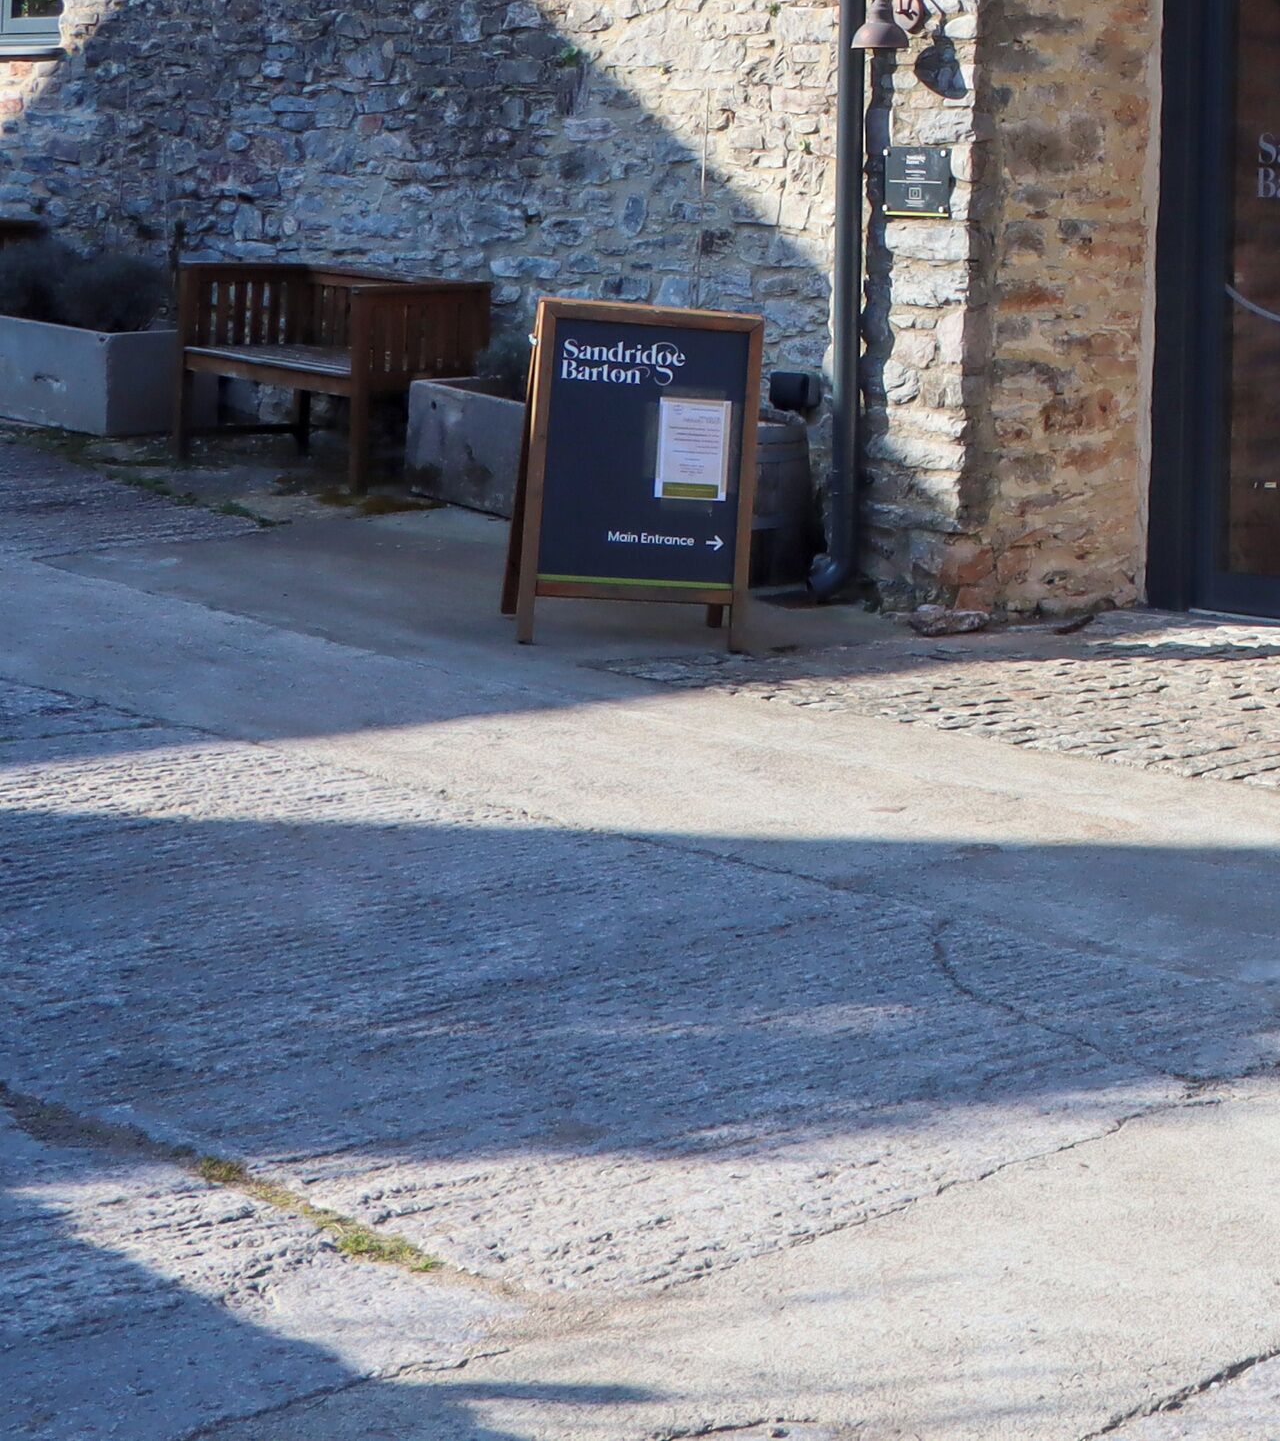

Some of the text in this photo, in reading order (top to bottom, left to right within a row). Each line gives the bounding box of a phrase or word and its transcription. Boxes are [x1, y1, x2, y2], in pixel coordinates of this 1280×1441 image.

[561, 359, 650, 384] Barton
[563, 338, 686, 386] Sandridge
[607, 530, 695, 547] Main Entrance
